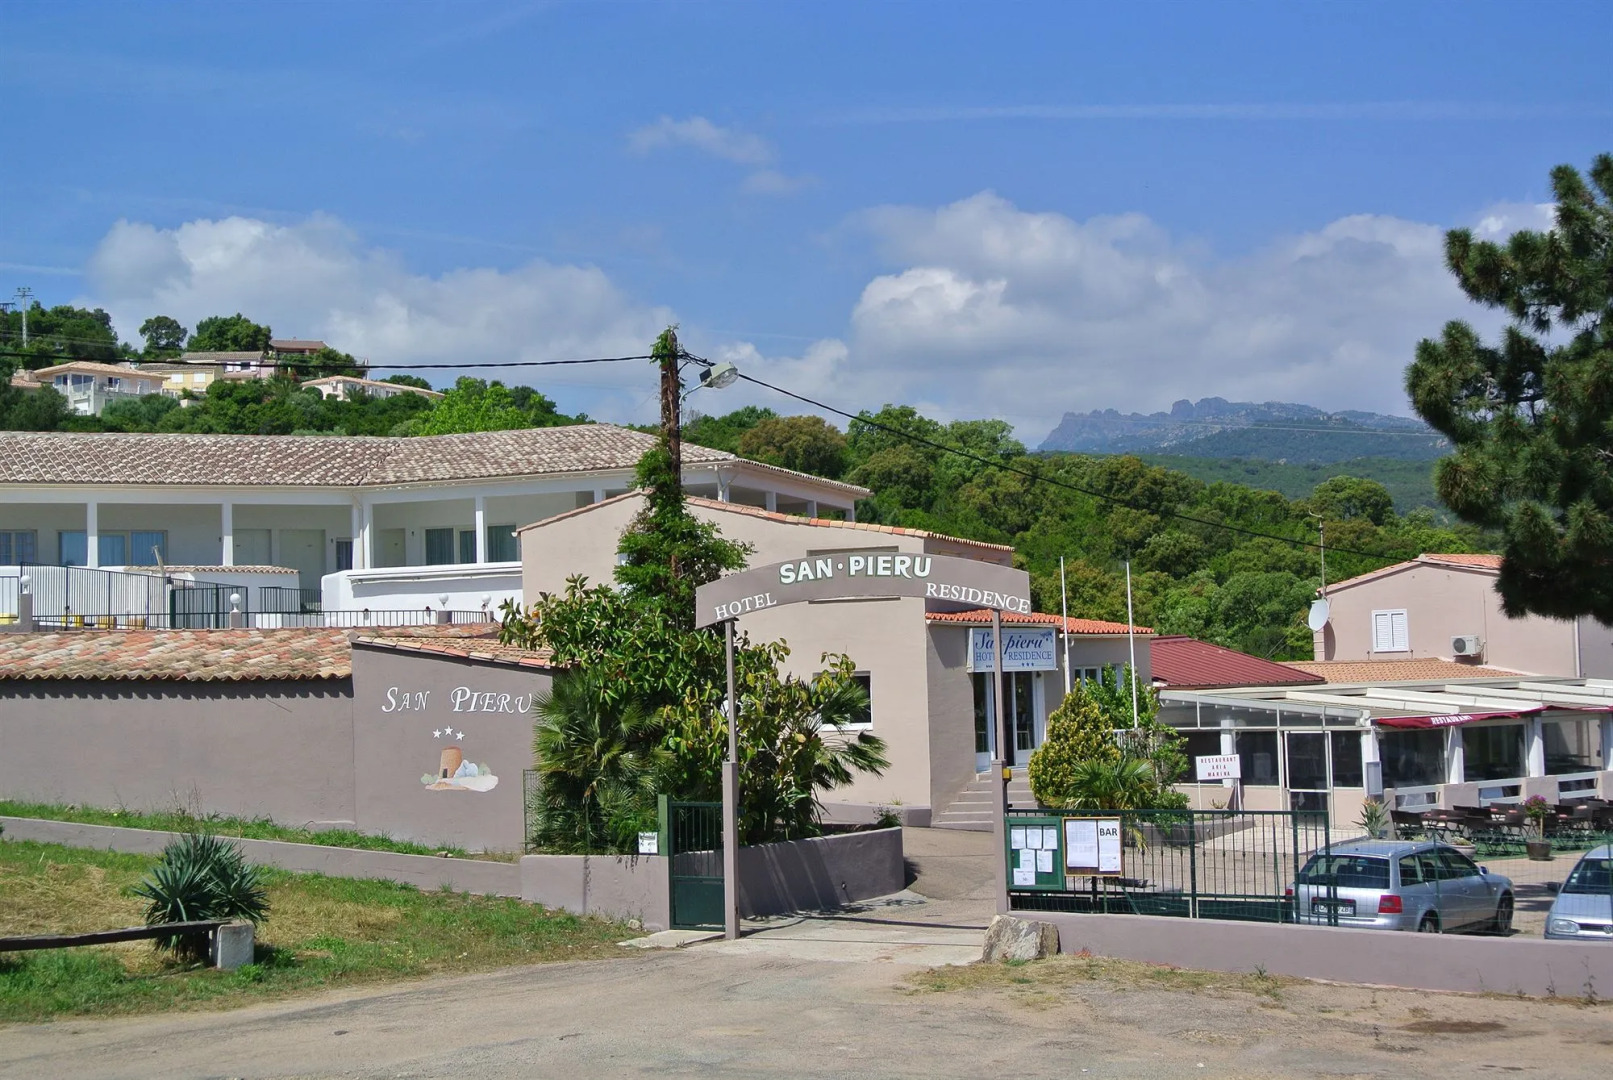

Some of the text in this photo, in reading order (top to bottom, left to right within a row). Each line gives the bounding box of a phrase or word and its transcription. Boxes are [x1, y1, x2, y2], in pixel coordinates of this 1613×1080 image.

[779, 555, 933, 585] SAN PIERU
[714, 582, 1031, 619] HOTEL RESIDENCE
[1008, 650, 1052, 661] RESIDENCE
[1099, 827, 1118, 837] BAR
